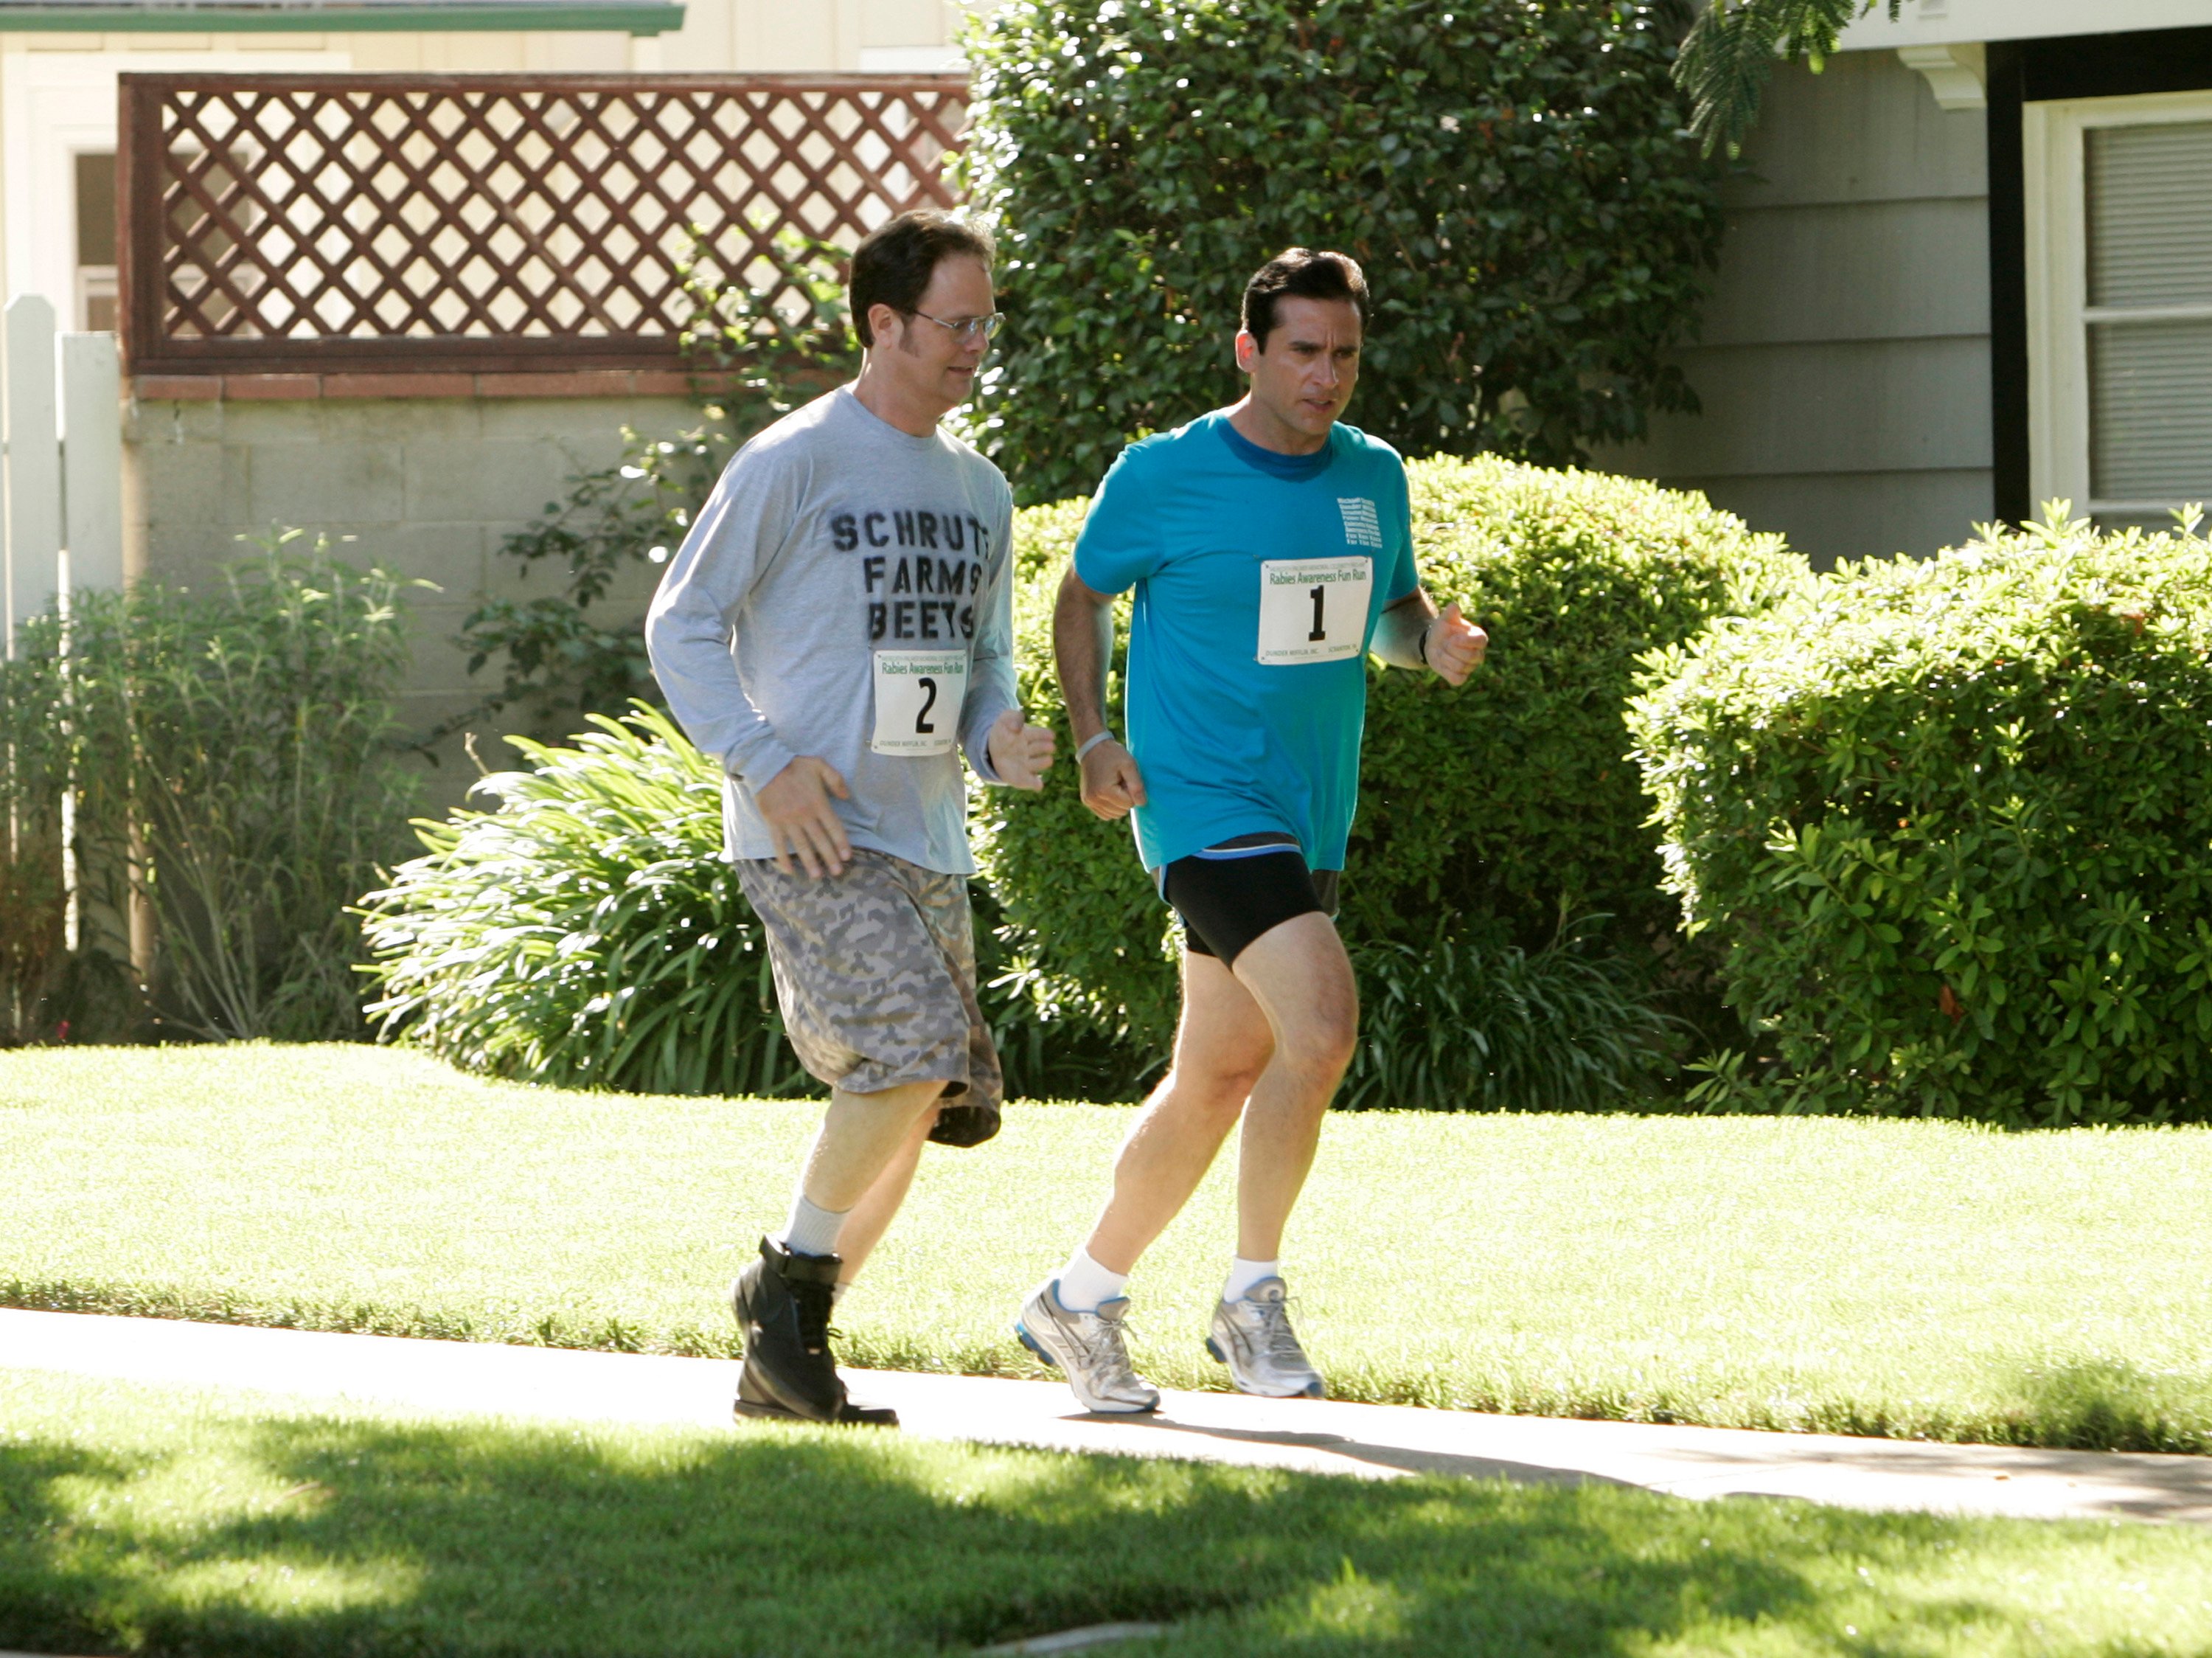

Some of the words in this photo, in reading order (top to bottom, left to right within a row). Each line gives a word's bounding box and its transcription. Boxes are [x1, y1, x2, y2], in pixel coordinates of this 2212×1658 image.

[863, 555, 982, 595] FARMS
[1269, 572, 1295, 585] Rabies
[1297, 570, 1336, 584] Awareness
[1338, 569, 1351, 582] Fun
[1352, 568, 1366, 580] Run
[868, 600, 975, 639] BEETS
[1308, 584, 1326, 642] 1
[882, 662, 908, 674] Rabies
[916, 676, 937, 734] 2
